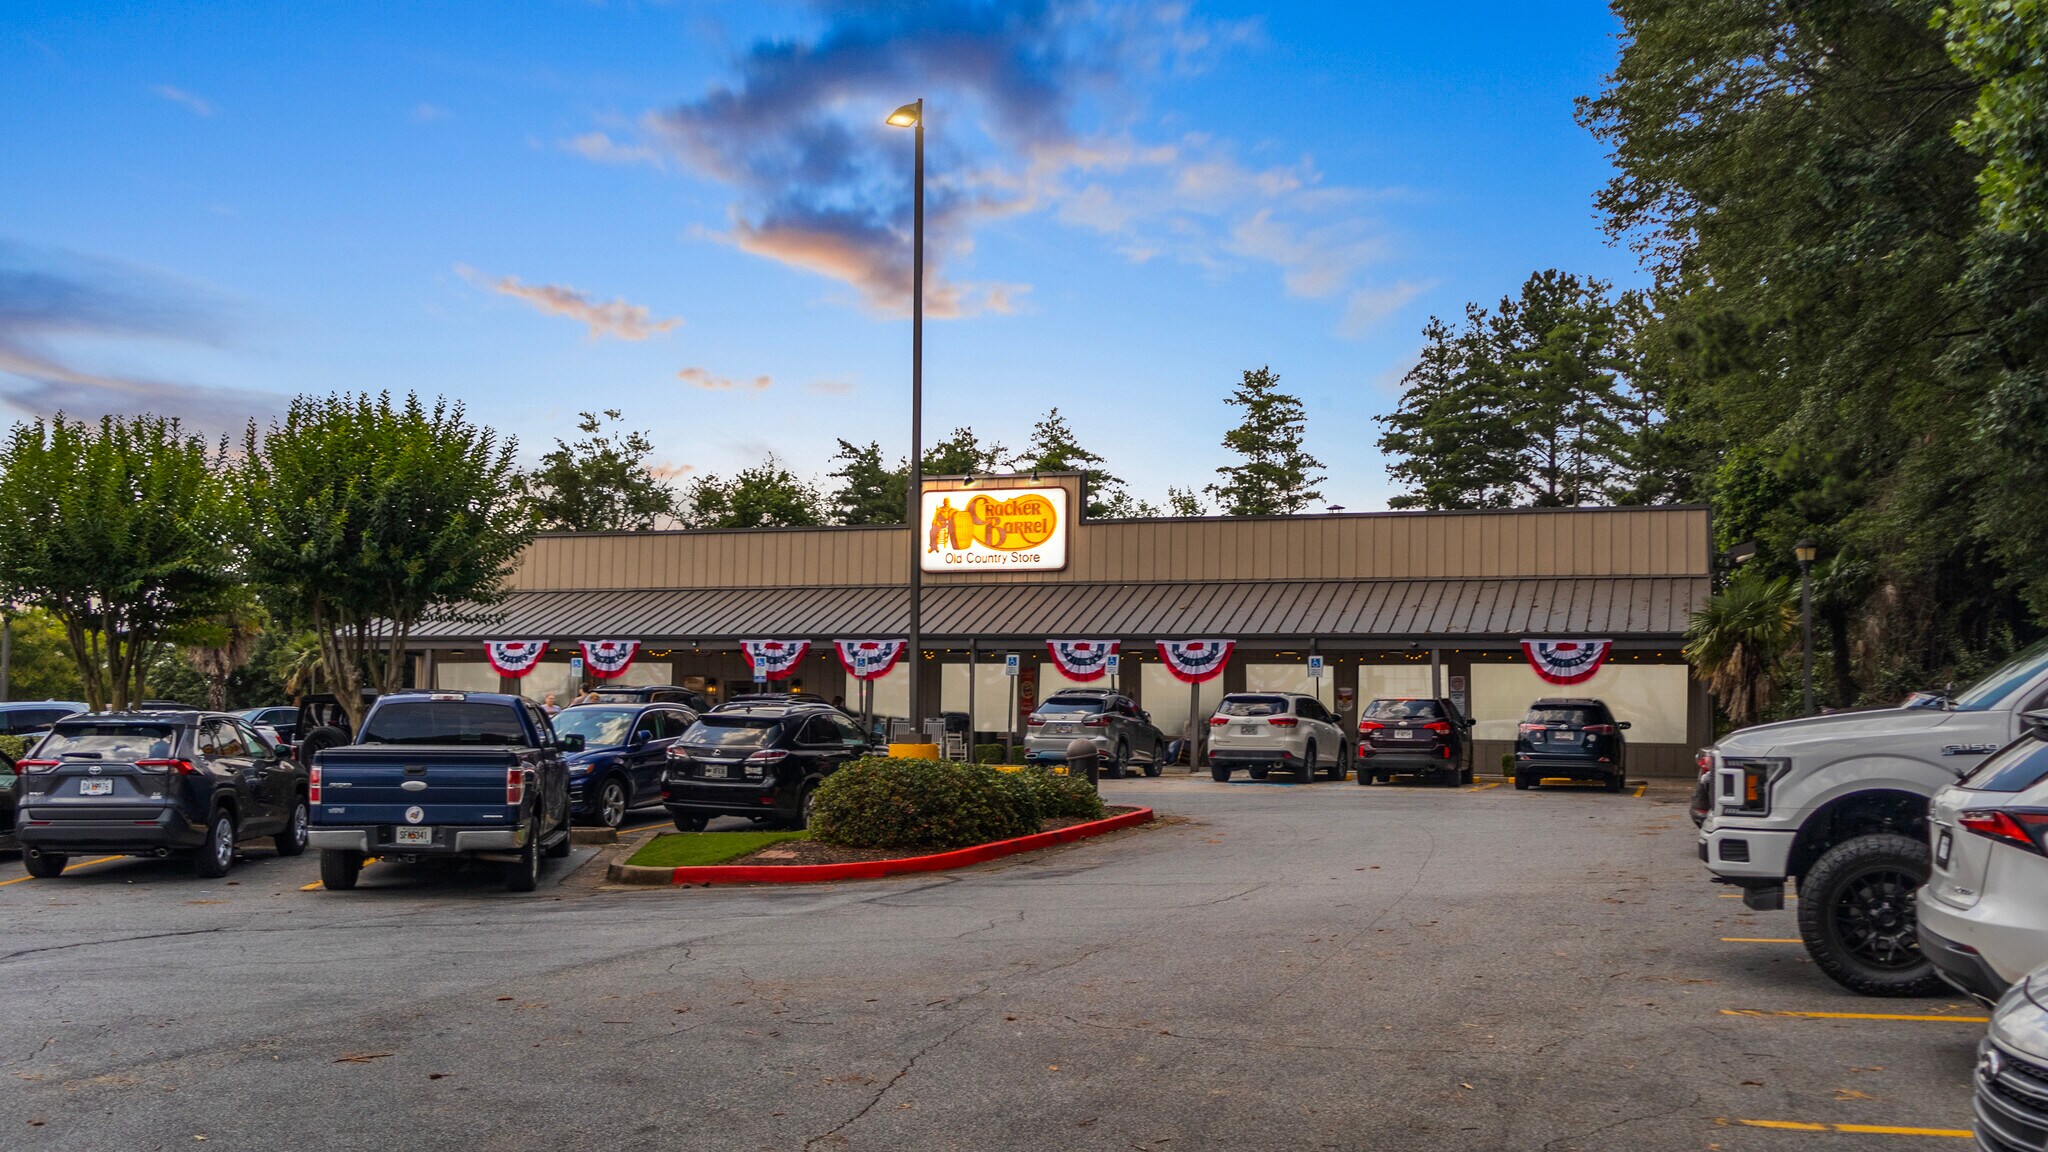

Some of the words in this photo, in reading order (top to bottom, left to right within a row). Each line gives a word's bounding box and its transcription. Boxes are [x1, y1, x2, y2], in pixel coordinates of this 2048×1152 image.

[968, 497, 1042, 525] Cracker
[985, 516, 1048, 547] Barrel
[945, 552, 963, 564] Old
[966, 552, 1008, 565] Country
[1010, 551, 1041, 563] Store
